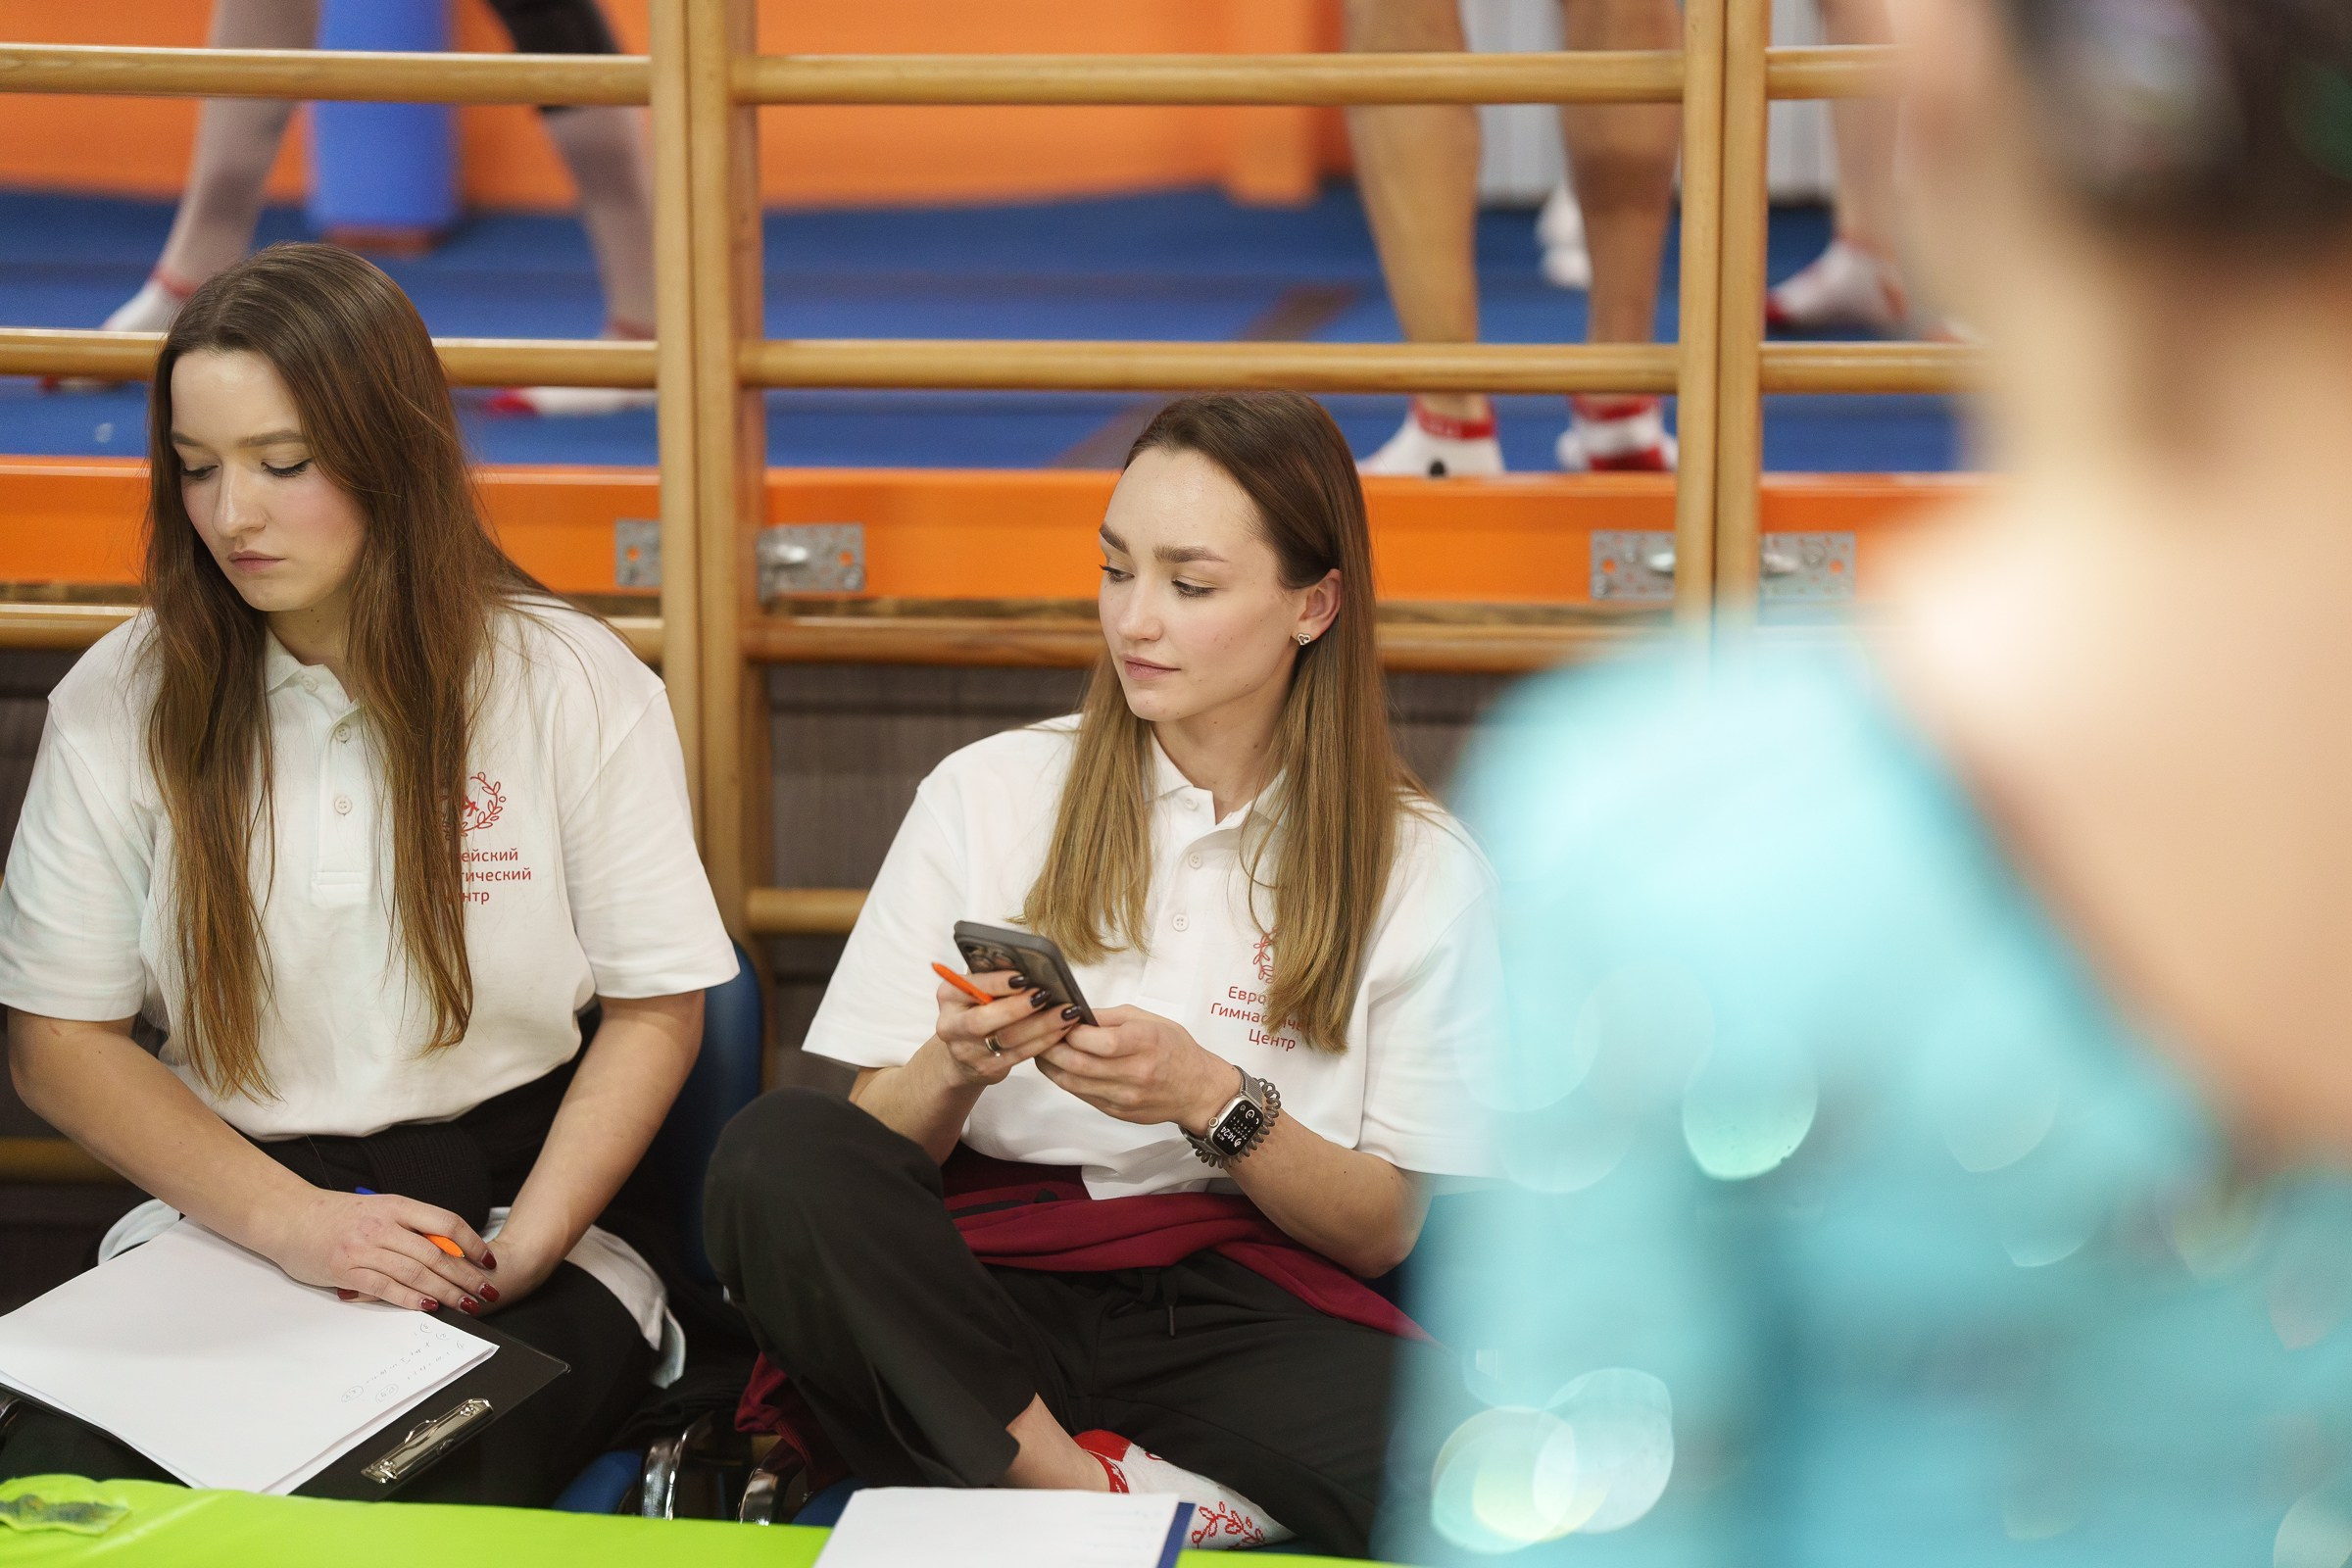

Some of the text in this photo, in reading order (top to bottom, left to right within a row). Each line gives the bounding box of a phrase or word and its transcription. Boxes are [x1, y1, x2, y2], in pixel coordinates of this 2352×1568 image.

[461, 848, 518, 862] ейский
[462, 867, 532, 882] ический
[463, 891, 490, 905] нтр
[1249, 1029, 1296, 1052] Центр
